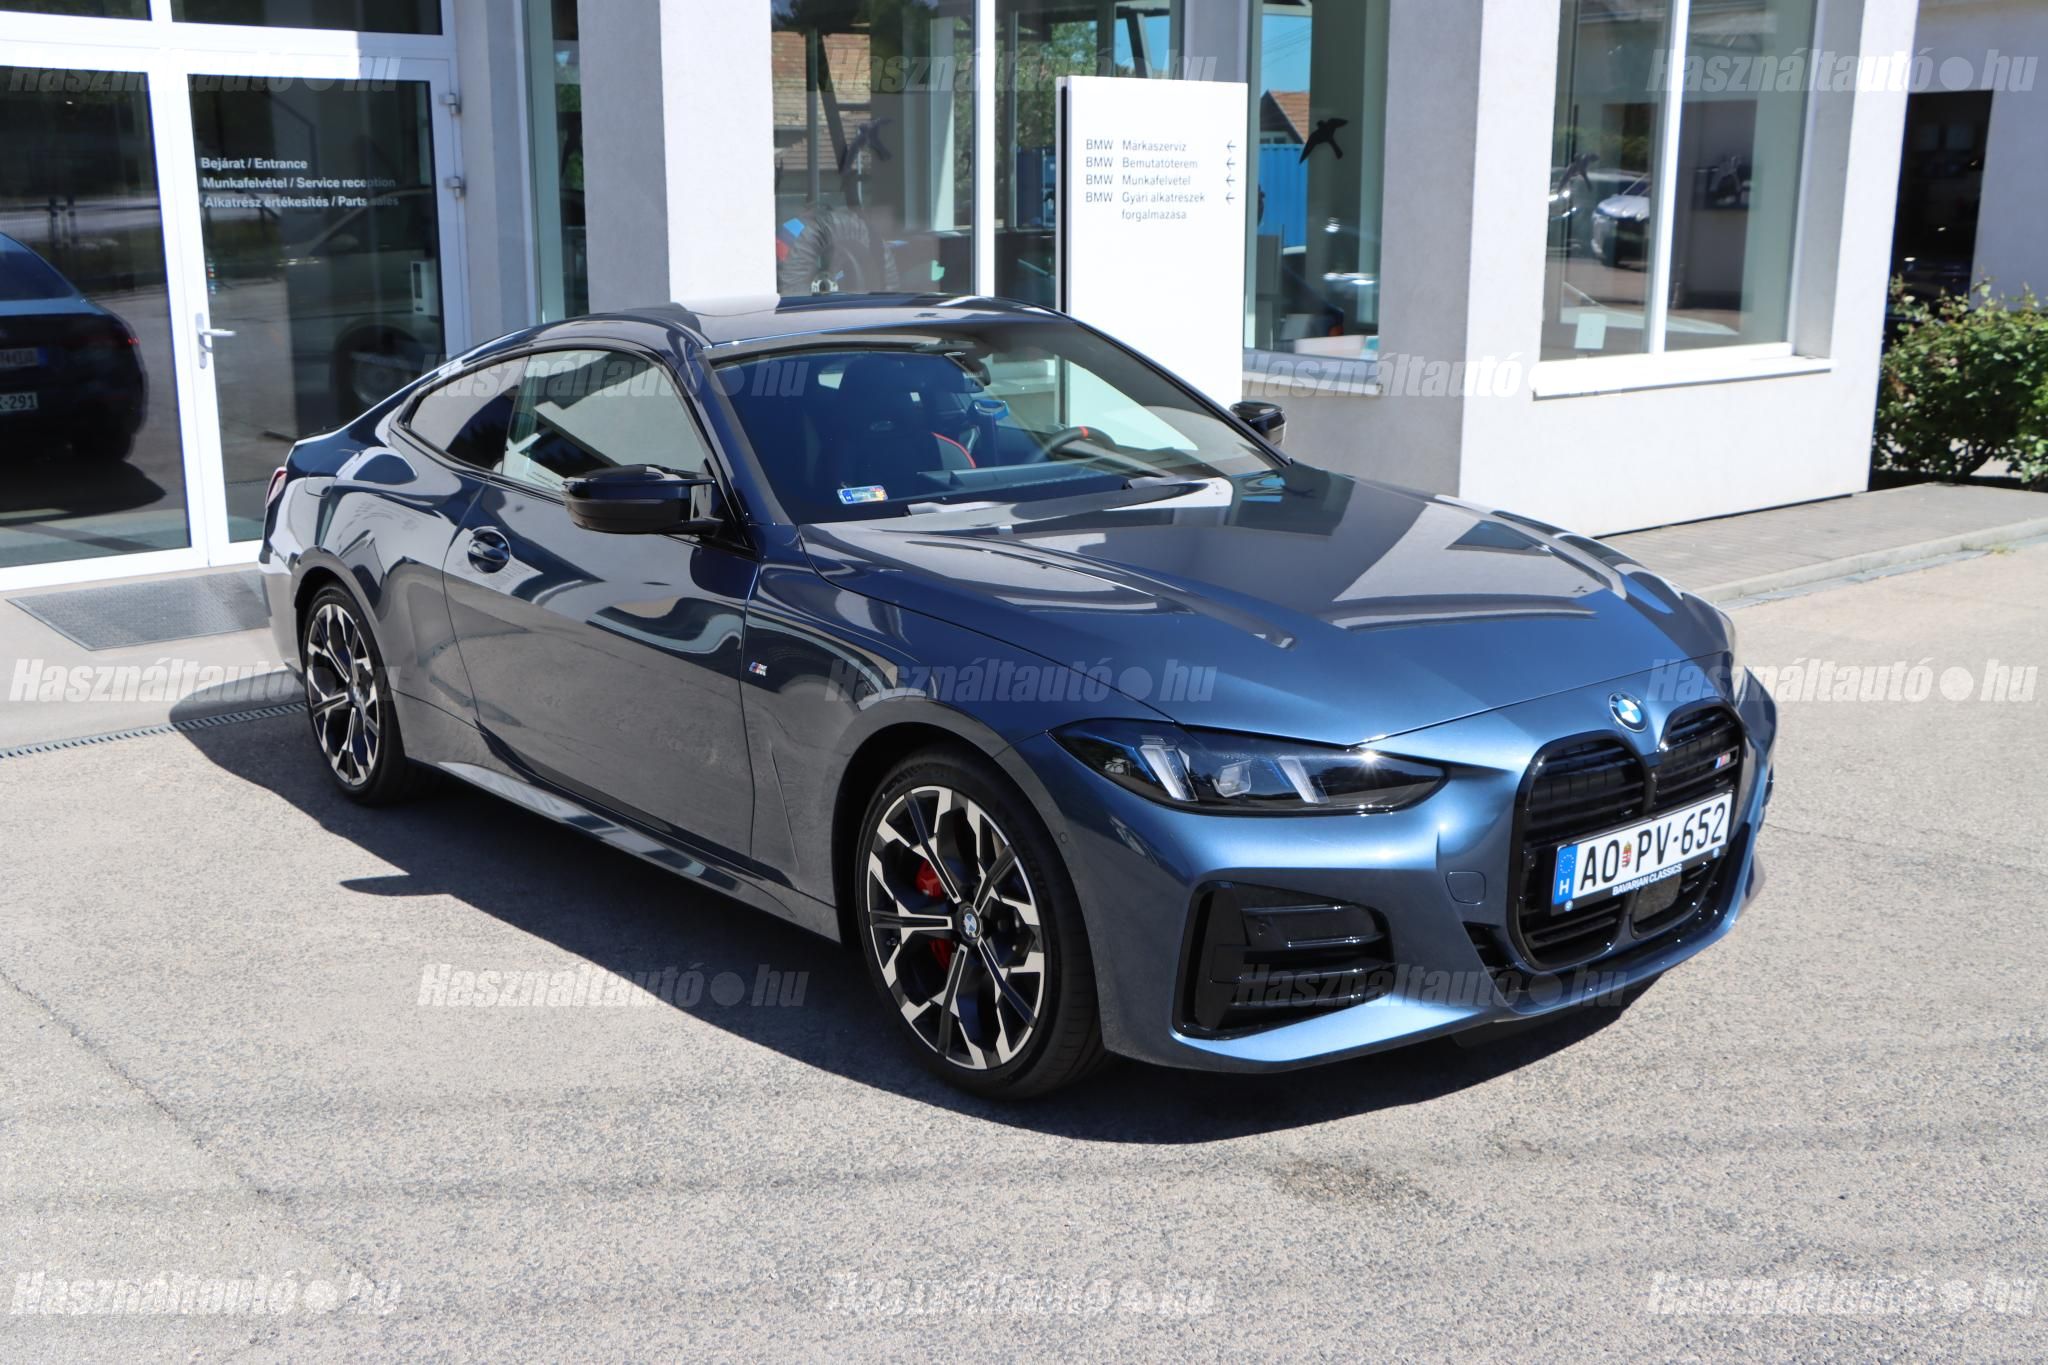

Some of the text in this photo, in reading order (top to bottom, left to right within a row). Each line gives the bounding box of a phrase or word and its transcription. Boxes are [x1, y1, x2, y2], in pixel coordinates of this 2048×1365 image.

[1086, 139, 1114, 150] BMW
[200, 157, 246, 171] Bejárat
[254, 158, 308, 169] Entrance
[1086, 157, 1114, 167] BMW
[202, 177, 288, 188] Munkafelvétel
[297, 177, 340, 188] Service
[1086, 174, 1114, 185] BMW
[204, 196, 262, 208] Alkatrész
[338, 196, 368, 207] Parts
[1085, 191, 1114, 203] BMW
[1612, 863, 1683, 896] BAVARIAN CLASSICS
[1558, 877, 1571, 896] H
